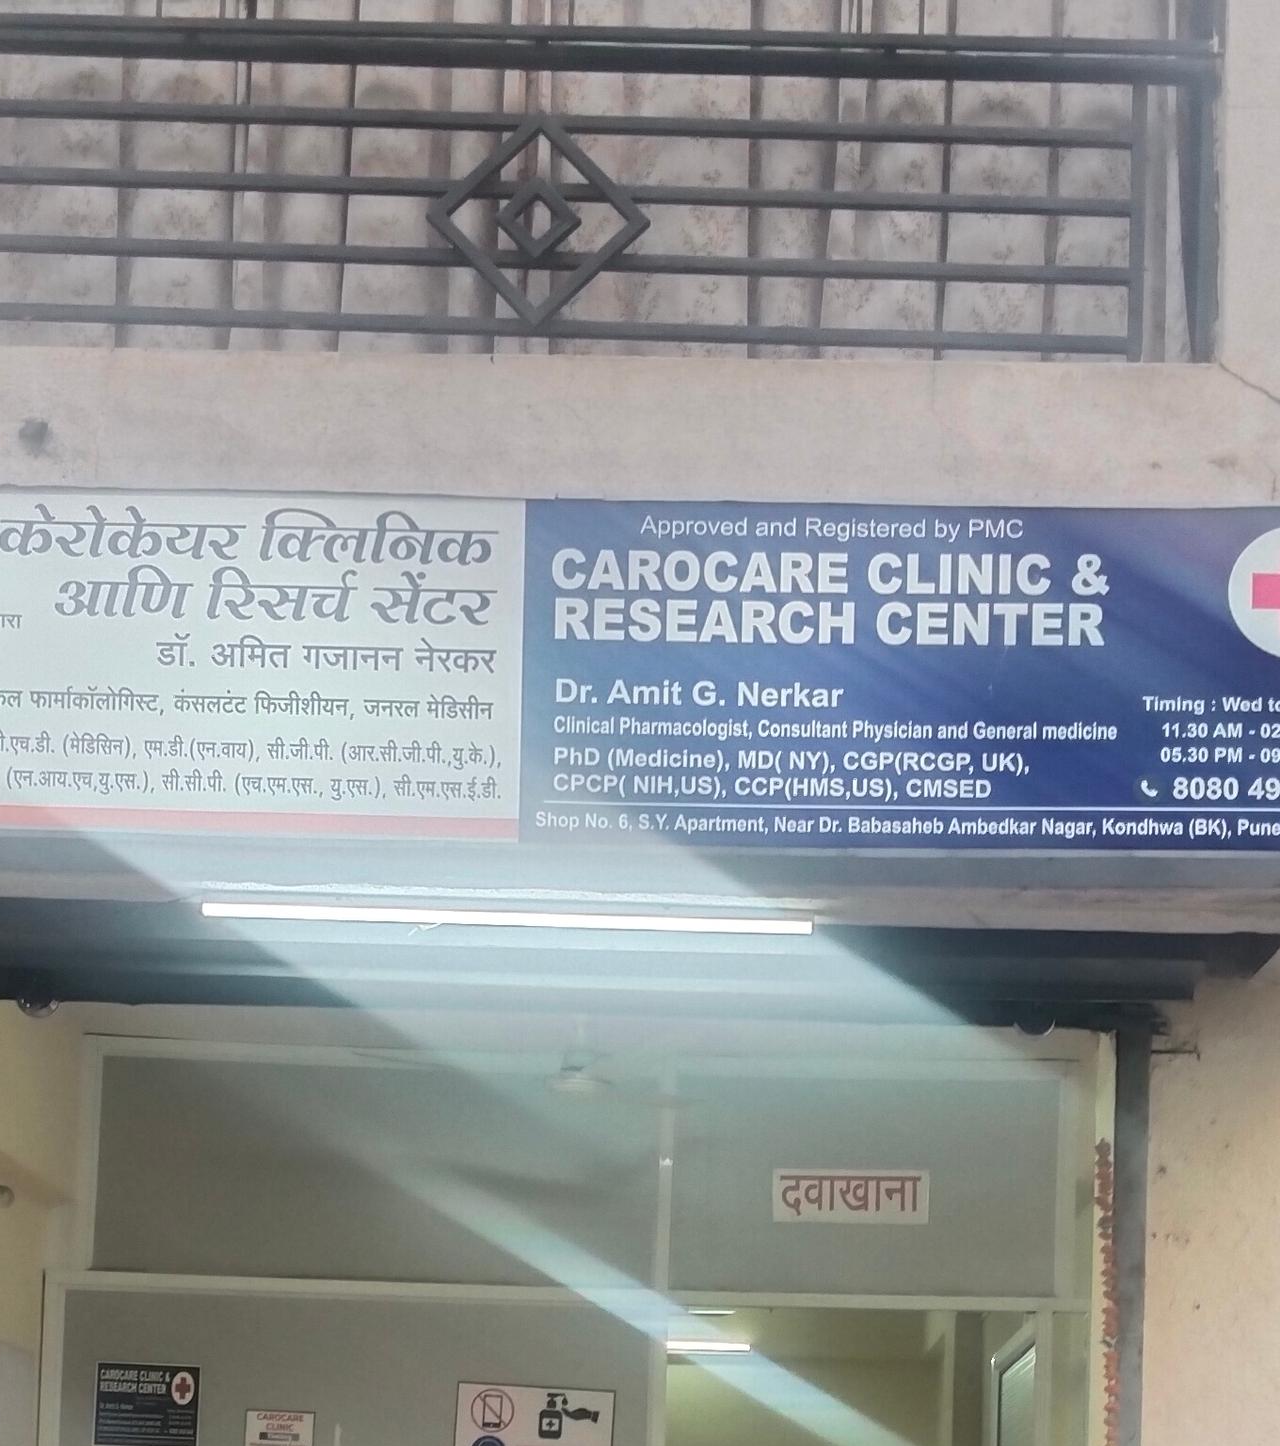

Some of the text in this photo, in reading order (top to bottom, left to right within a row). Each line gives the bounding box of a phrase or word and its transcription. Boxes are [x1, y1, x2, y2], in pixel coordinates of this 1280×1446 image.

[0, 504, 498, 565] केरोकेयर क्लिनिक
[640, 515, 1024, 542] Approved and Registered by PMC
[552, 548, 1110, 596] CAROCARE CLINIC &
[55, 564, 498, 625] आणि रिसर्च सेंटर
[554, 597, 1105, 646] RESEARCH CENTER
[156, 633, 497, 673] डॉ. अमित गजानन नेरकर
[365, 699, 420, 718] जनरल
[427, 694, 493, 720] मेडिसीन
[555, 678, 844, 708] Dr. Amit G. Nerkar
[1143, 696, 1205, 715] Timing
[1222, 697, 1262, 712] Wed
[554, 716, 1117, 745] Clinical Pharmacologist, Consultant Physician and General medicine
[1162, 723, 1208, 738] 11.30
[1213, 723, 1242, 739] AM
[554, 747, 600, 766] PhD
[607, 748, 730, 772] (Medicine),
[788, 751, 835, 773] NY),
[843, 752, 974, 775] CGP(RCGP,
[982, 753, 1030, 775] UK),
[1160, 747, 1208, 763] 05.30
[1214, 748, 1242, 763] PM
[734, 777, 897, 801] CCP(HMS,US),
[906, 779, 992, 798] CMSED
[1172, 777, 1239, 800] 8080
[536, 811, 579, 831] Shop
[585, 812, 613, 829] No.
[638, 814, 670, 830] S.Y.
[674, 815, 769, 836] Apartment,
[775, 817, 814, 832] Near
[819, 817, 842, 833] Dr.
[848, 817, 943, 834] Babasaheb
[948, 817, 1036, 835] Ambedkar
[1042, 818, 1097, 839] Nagar,
[1102, 819, 1183, 836] Kondhwa
[1188, 820, 1231, 840] (BK),
[1237, 820, 1280, 837] Pune
[780, 1175, 922, 1216] दवाखाना
